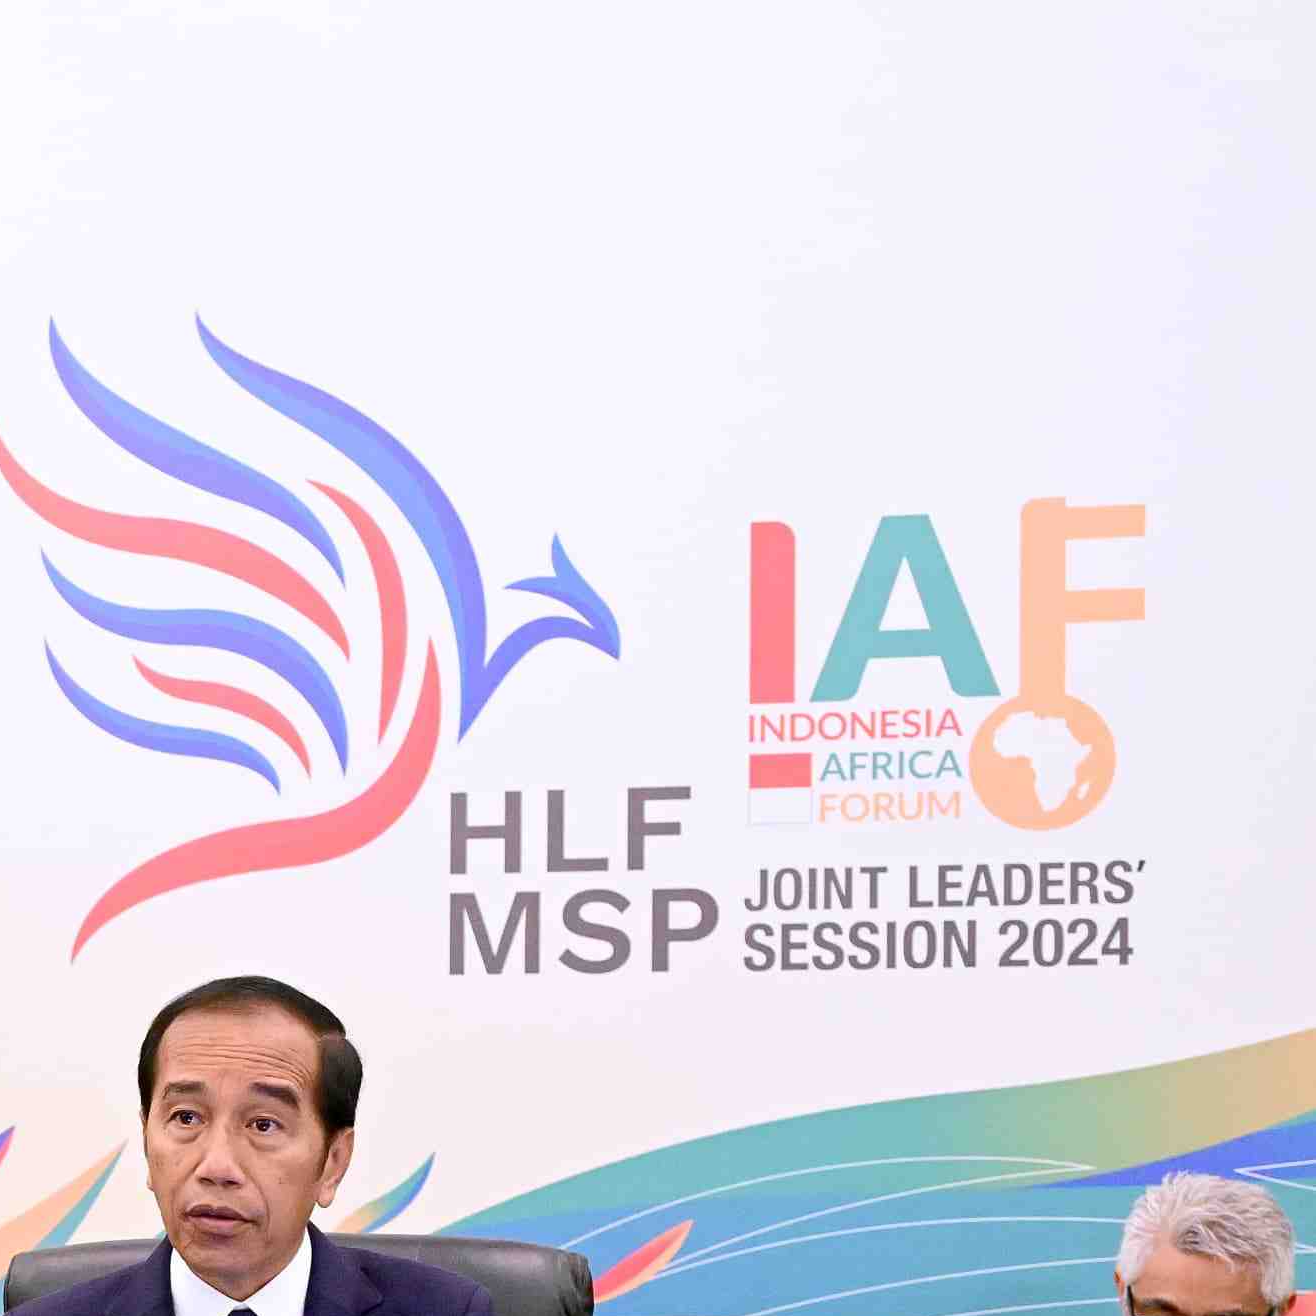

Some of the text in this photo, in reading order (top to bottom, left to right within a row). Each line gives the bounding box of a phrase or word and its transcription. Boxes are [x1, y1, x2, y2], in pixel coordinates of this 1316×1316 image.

[749, 497, 1146, 704] IAF
[748, 709, 963, 743] INDONESIA
[820, 749, 962, 781] AFRICA
[449, 785, 692, 875] HLF
[819, 792, 961, 823] FORUM
[744, 866, 889, 912] JOINT
[448, 887, 719, 976] MSP
[743, 916, 1134, 972] SESSION 2024
